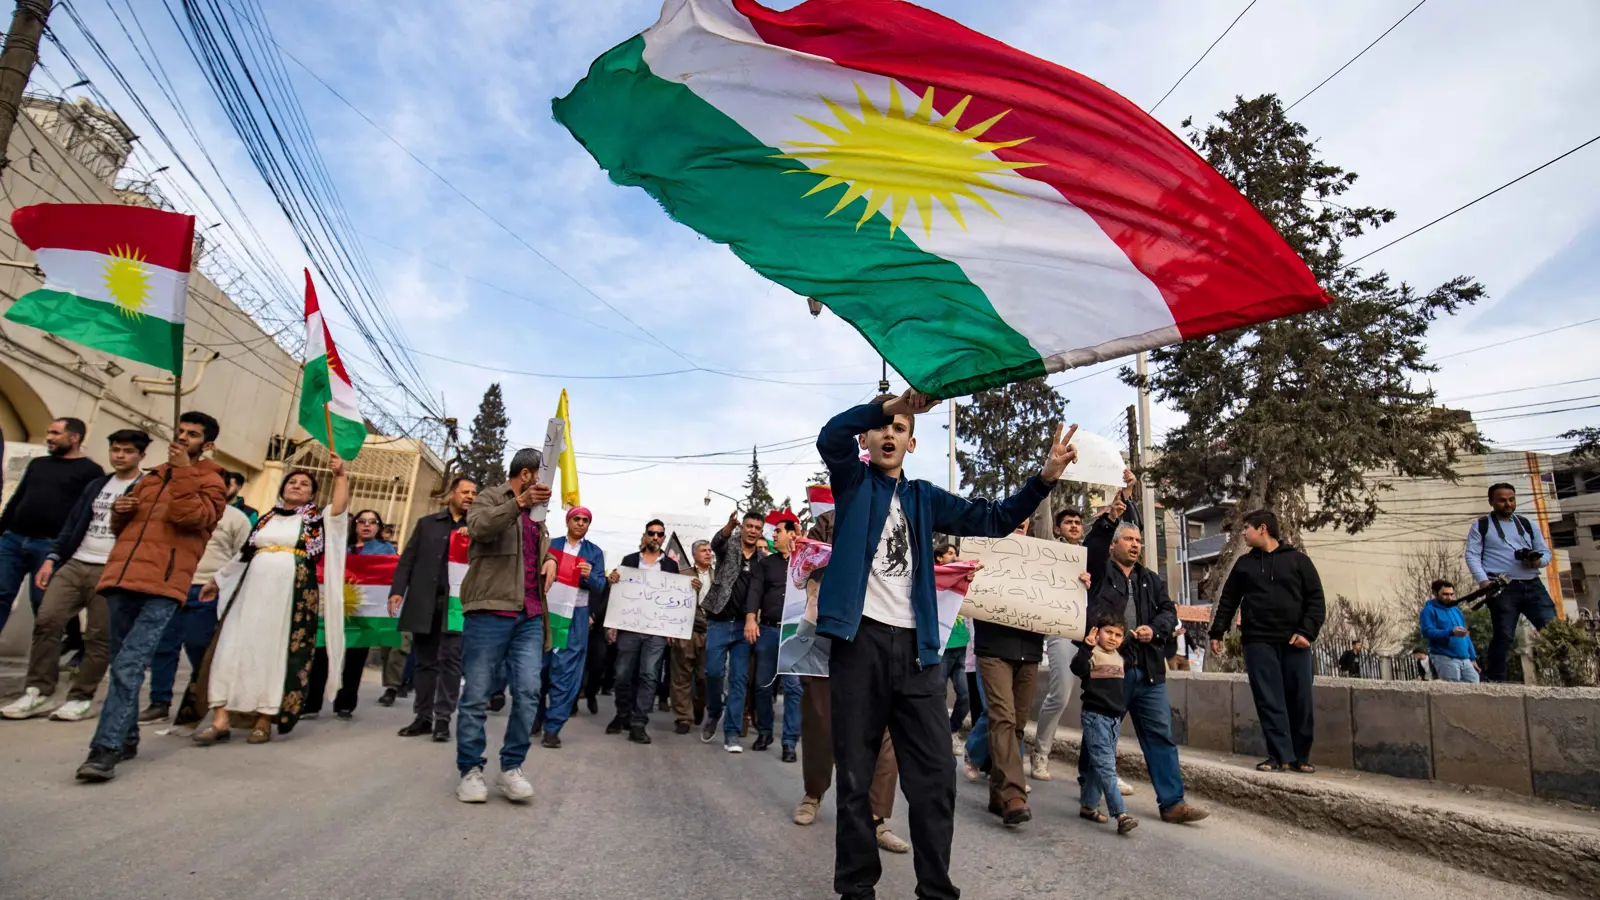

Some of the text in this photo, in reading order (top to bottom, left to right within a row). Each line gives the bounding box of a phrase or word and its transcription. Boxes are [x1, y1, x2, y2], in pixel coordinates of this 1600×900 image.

[981, 556, 1080, 591] دولة لا مركزي
[1041, 618, 1079, 631] دستور
